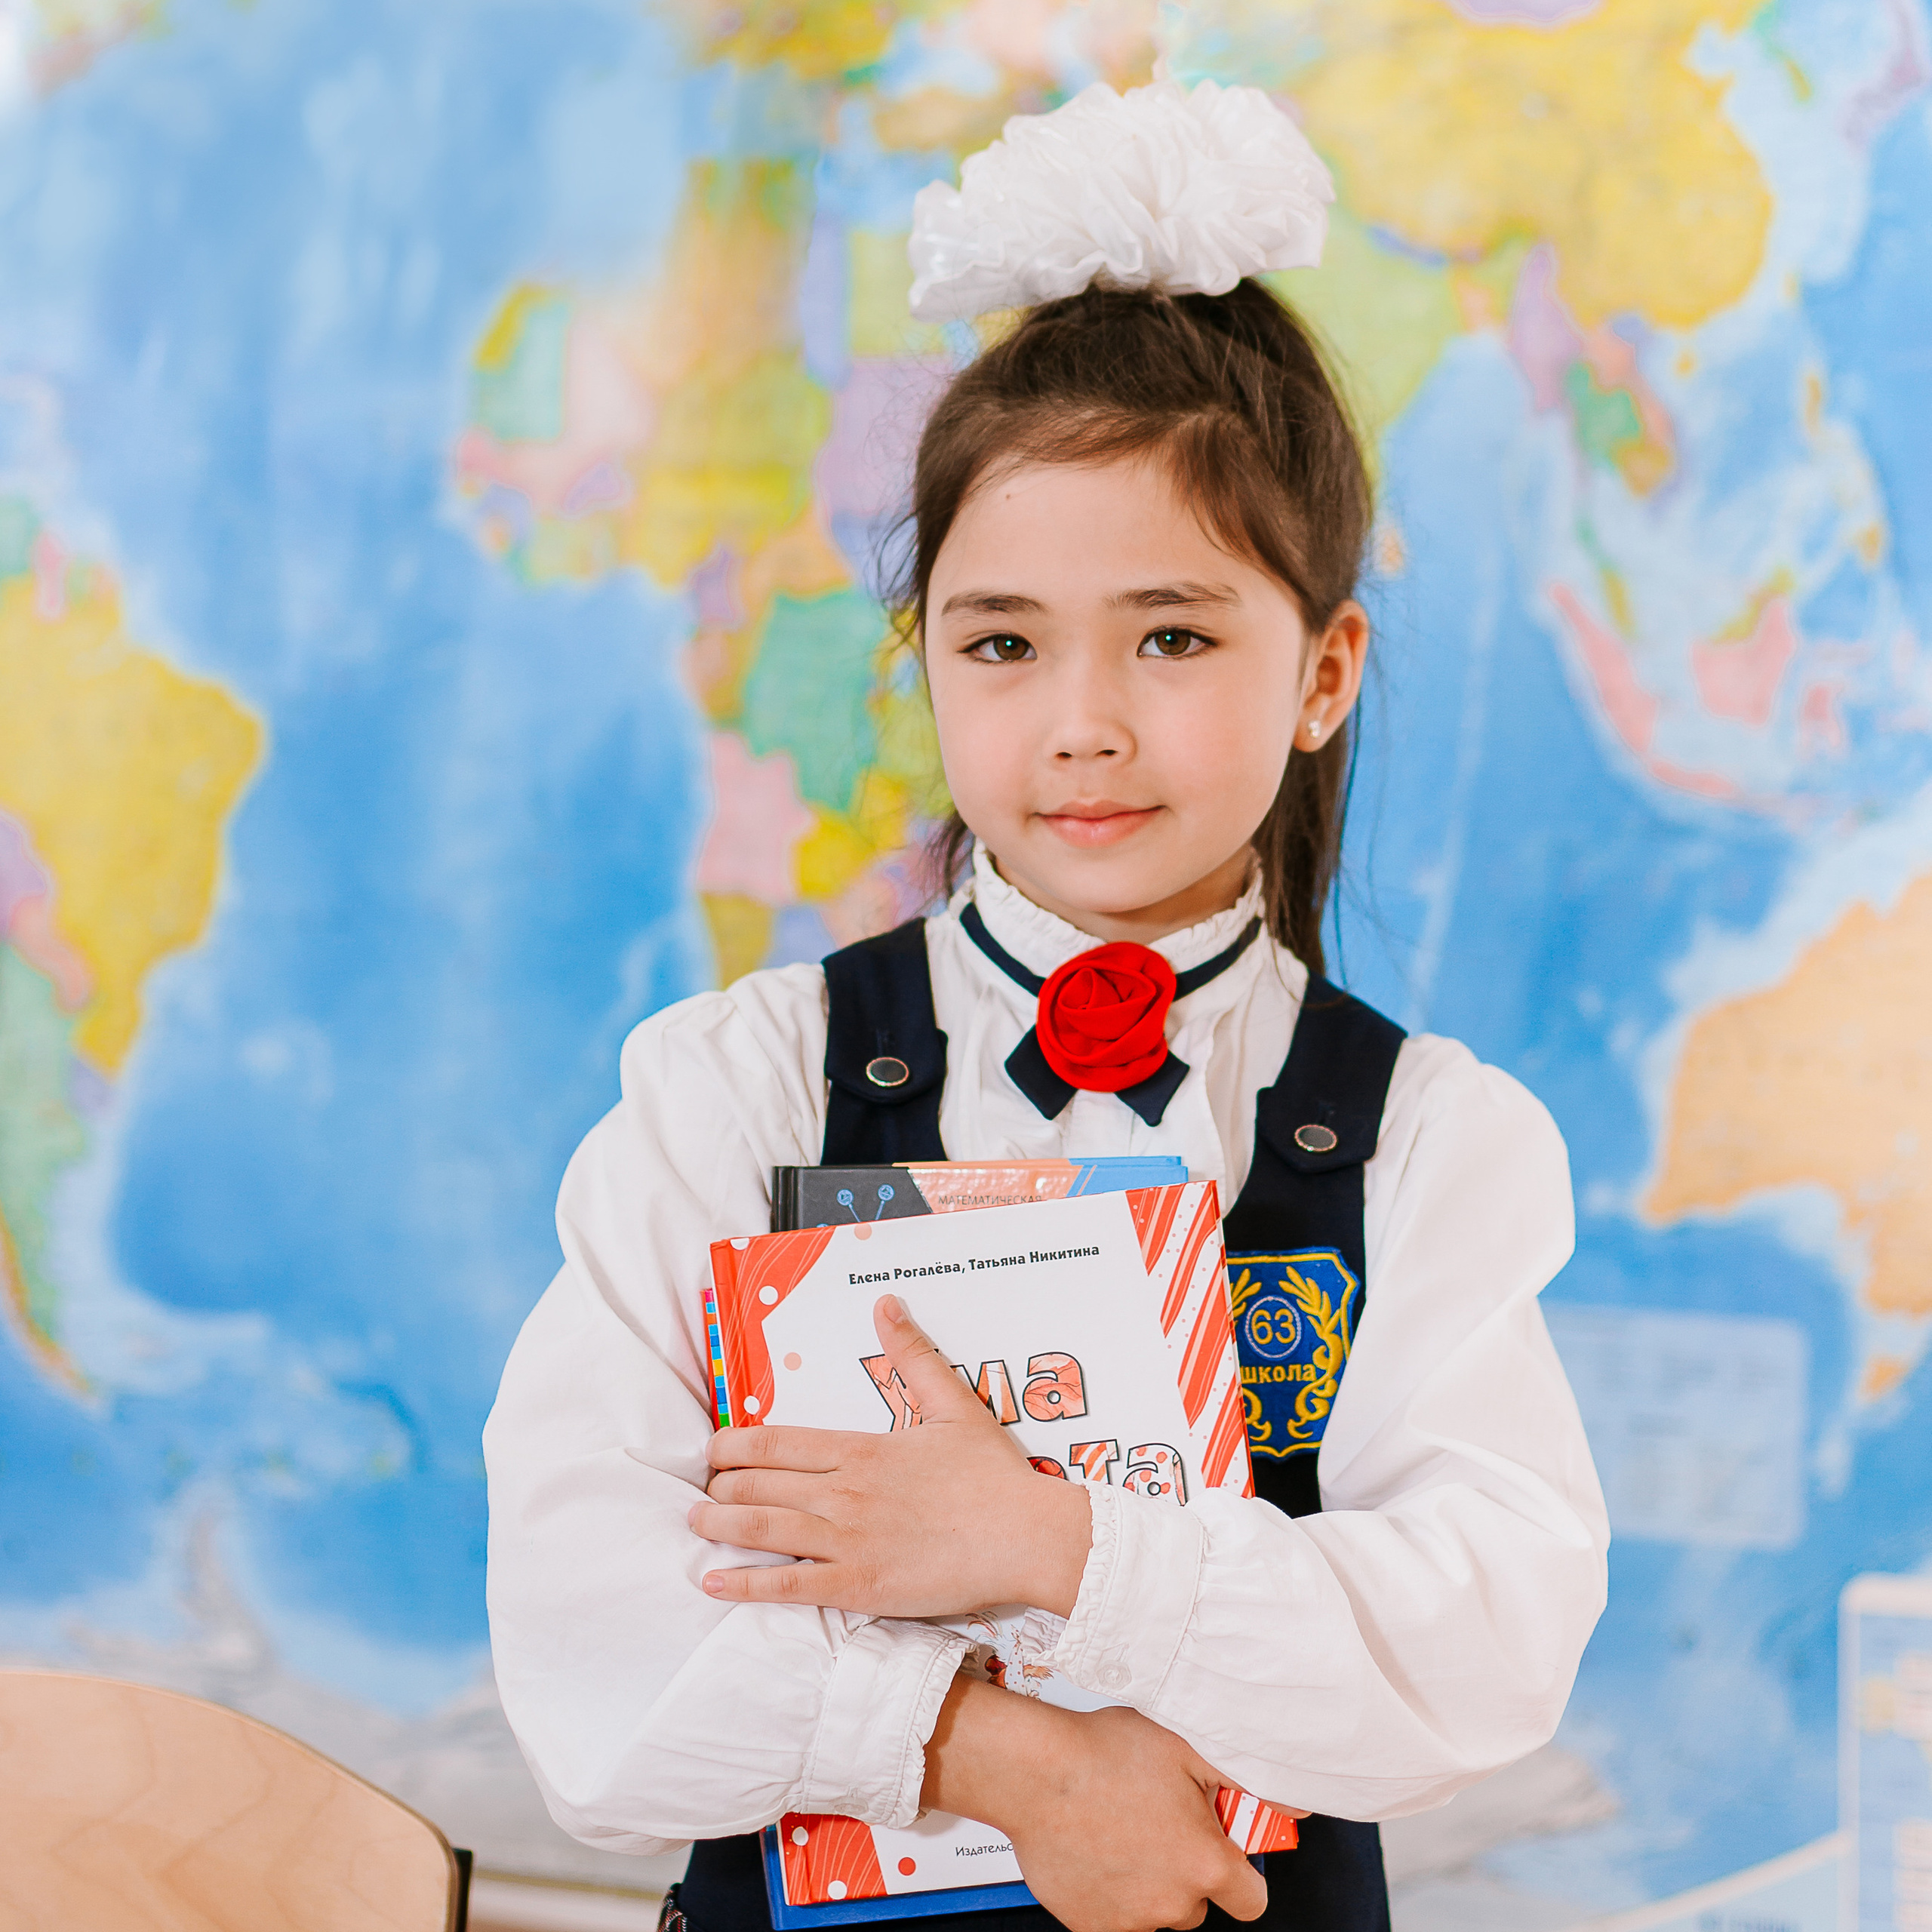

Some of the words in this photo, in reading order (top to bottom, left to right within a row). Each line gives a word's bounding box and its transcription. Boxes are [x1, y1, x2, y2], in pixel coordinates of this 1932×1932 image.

[848, 1272, 891, 1285] Елена
[894, 1261, 965, 1280] Рогалёва,
[968, 1255, 1026, 1271] Татьяна
[1029, 1246, 1100, 1263] Никитина
[1251, 1309, 1297, 1345] 63
[1240, 1364, 1317, 1384] школа
